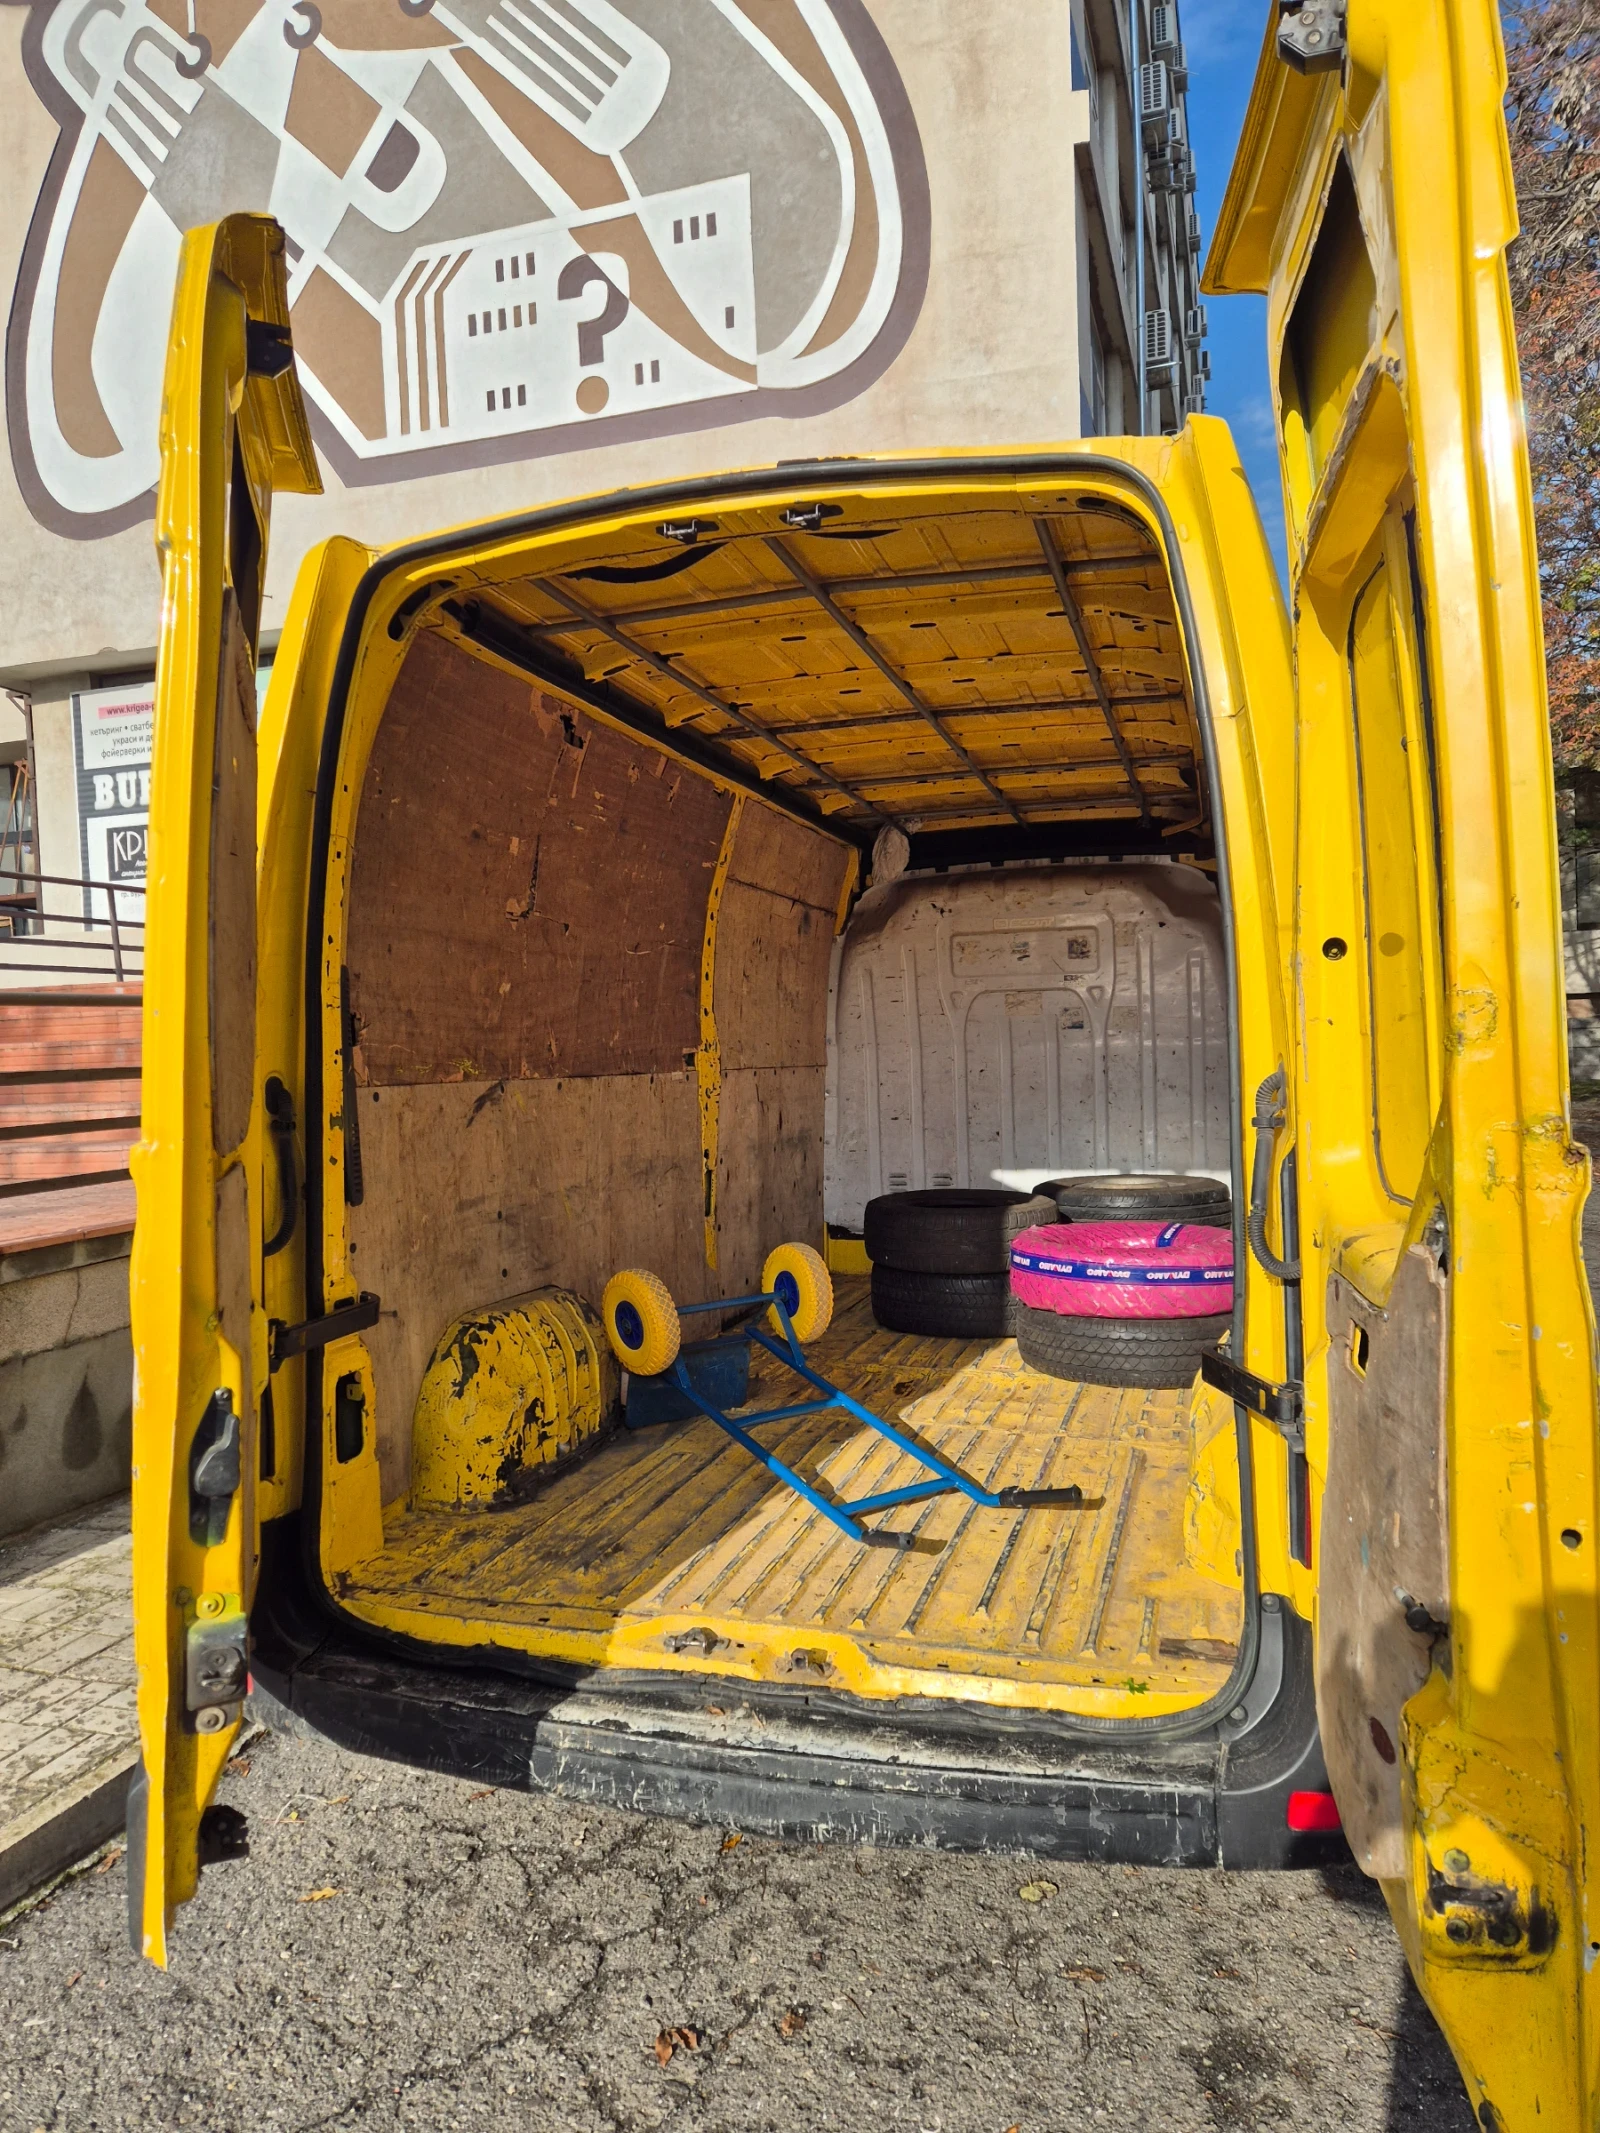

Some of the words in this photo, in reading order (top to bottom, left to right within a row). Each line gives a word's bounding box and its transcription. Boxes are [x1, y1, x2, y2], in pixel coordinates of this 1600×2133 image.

[130, 720, 154, 732] сватбе
[112, 735, 138, 748] украси
[100, 746, 146, 760] фойерверки
[1038, 1261, 1073, 1274] DYNAMO
[1086, 1268, 1131, 1278] DYNAMO
[1146, 1270, 1191, 1280] DYNAMO
